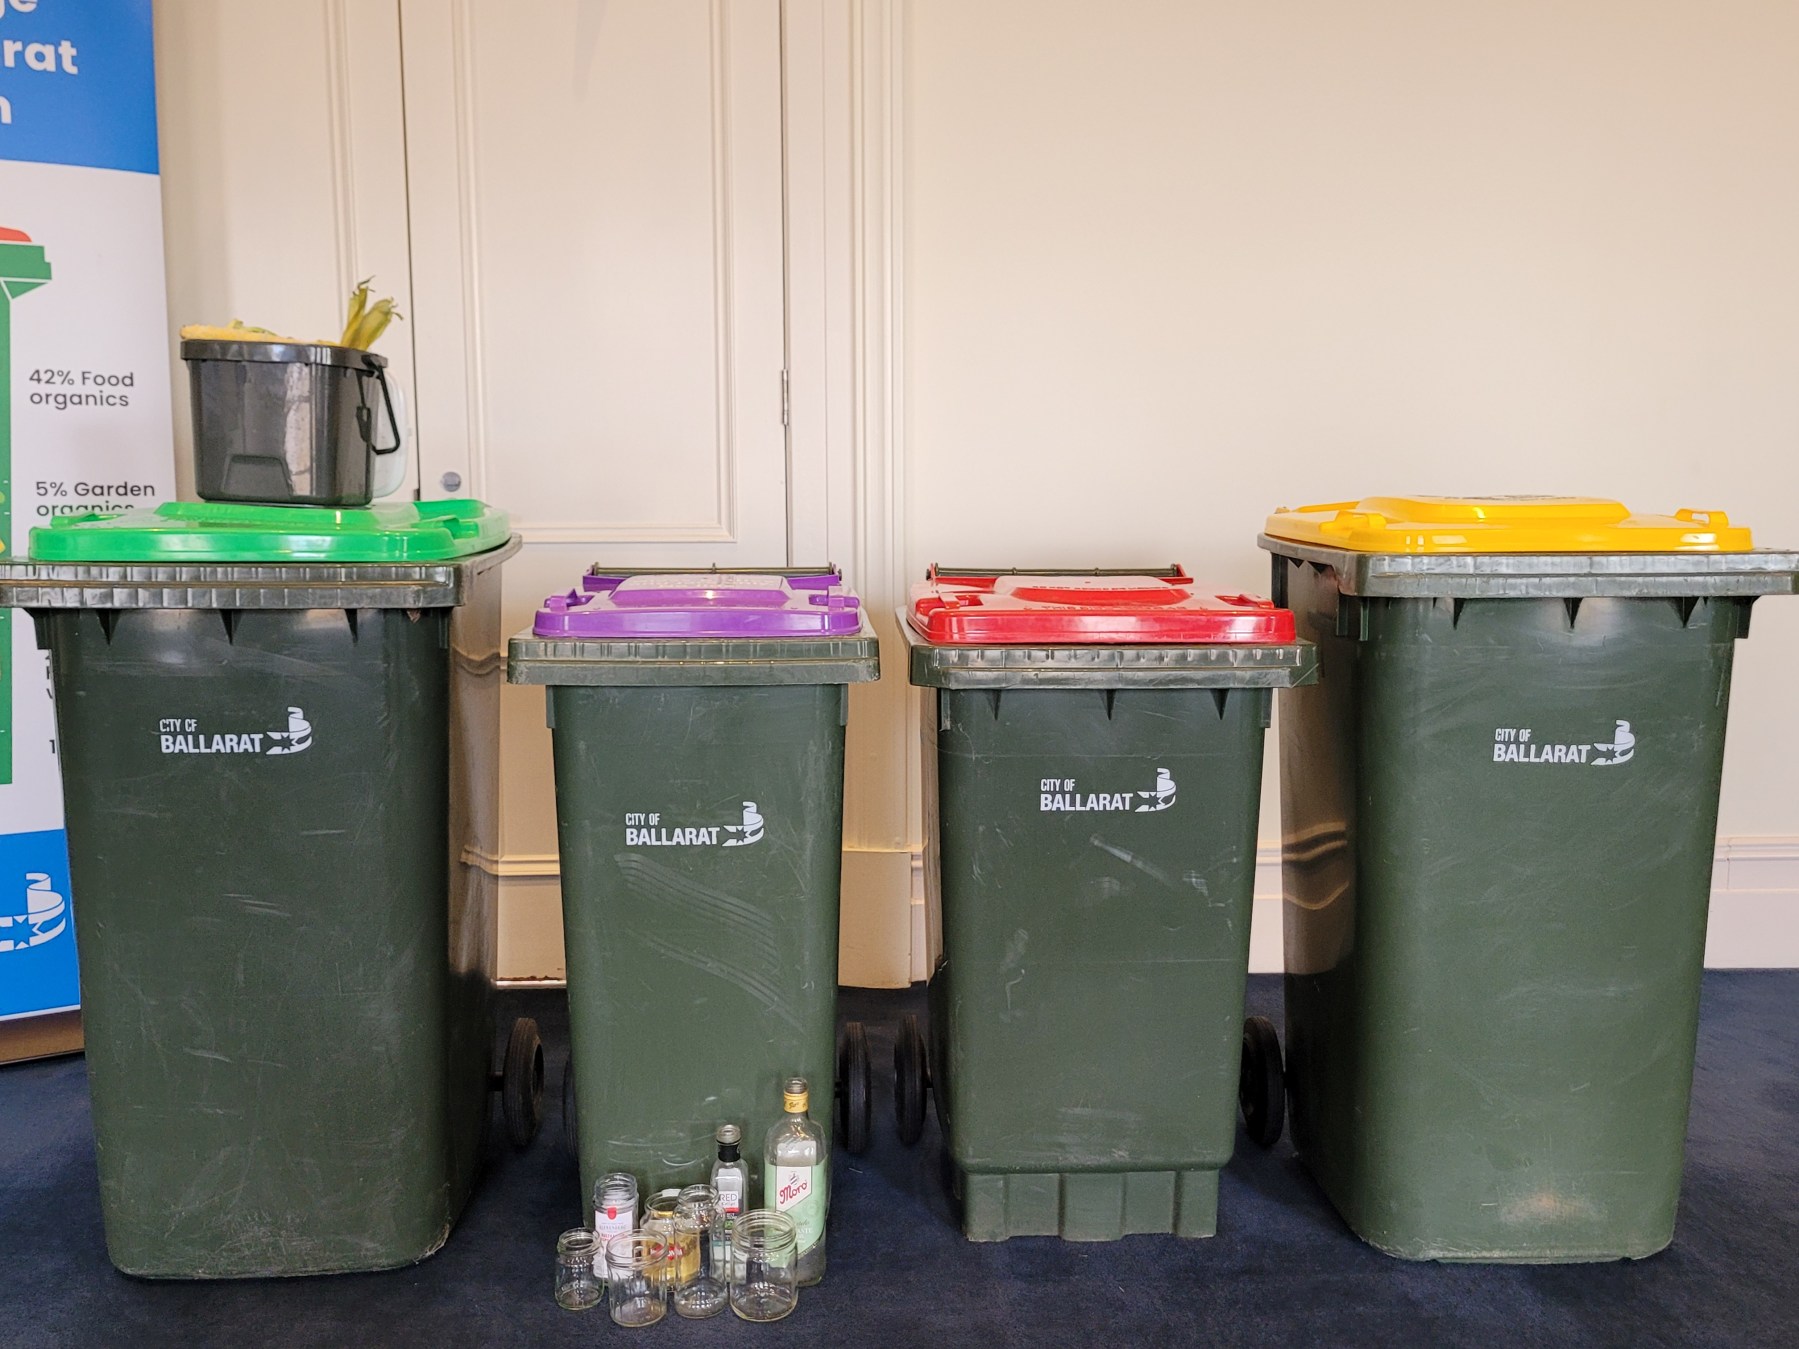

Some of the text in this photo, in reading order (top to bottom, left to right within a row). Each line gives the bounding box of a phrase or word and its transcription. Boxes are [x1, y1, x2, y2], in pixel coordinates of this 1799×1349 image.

[29, 369, 134, 387] 42% Food
[30, 391, 129, 410] organics
[36, 481, 155, 497] 5% Garden
[159, 718, 181, 732] CITY
[160, 733, 264, 753] BALLARAT
[1494, 728, 1532, 742] CITY OF
[1493, 743, 1592, 763] BALLARAT
[1040, 778, 1076, 792] CITY OF
[1040, 793, 1134, 812] BALLARAT
[625, 812, 661, 826] CITY OF
[625, 827, 721, 846] BALLARAT
[718, 1193, 738, 1202] RED
[779, 1183, 808, 1205] Moro
